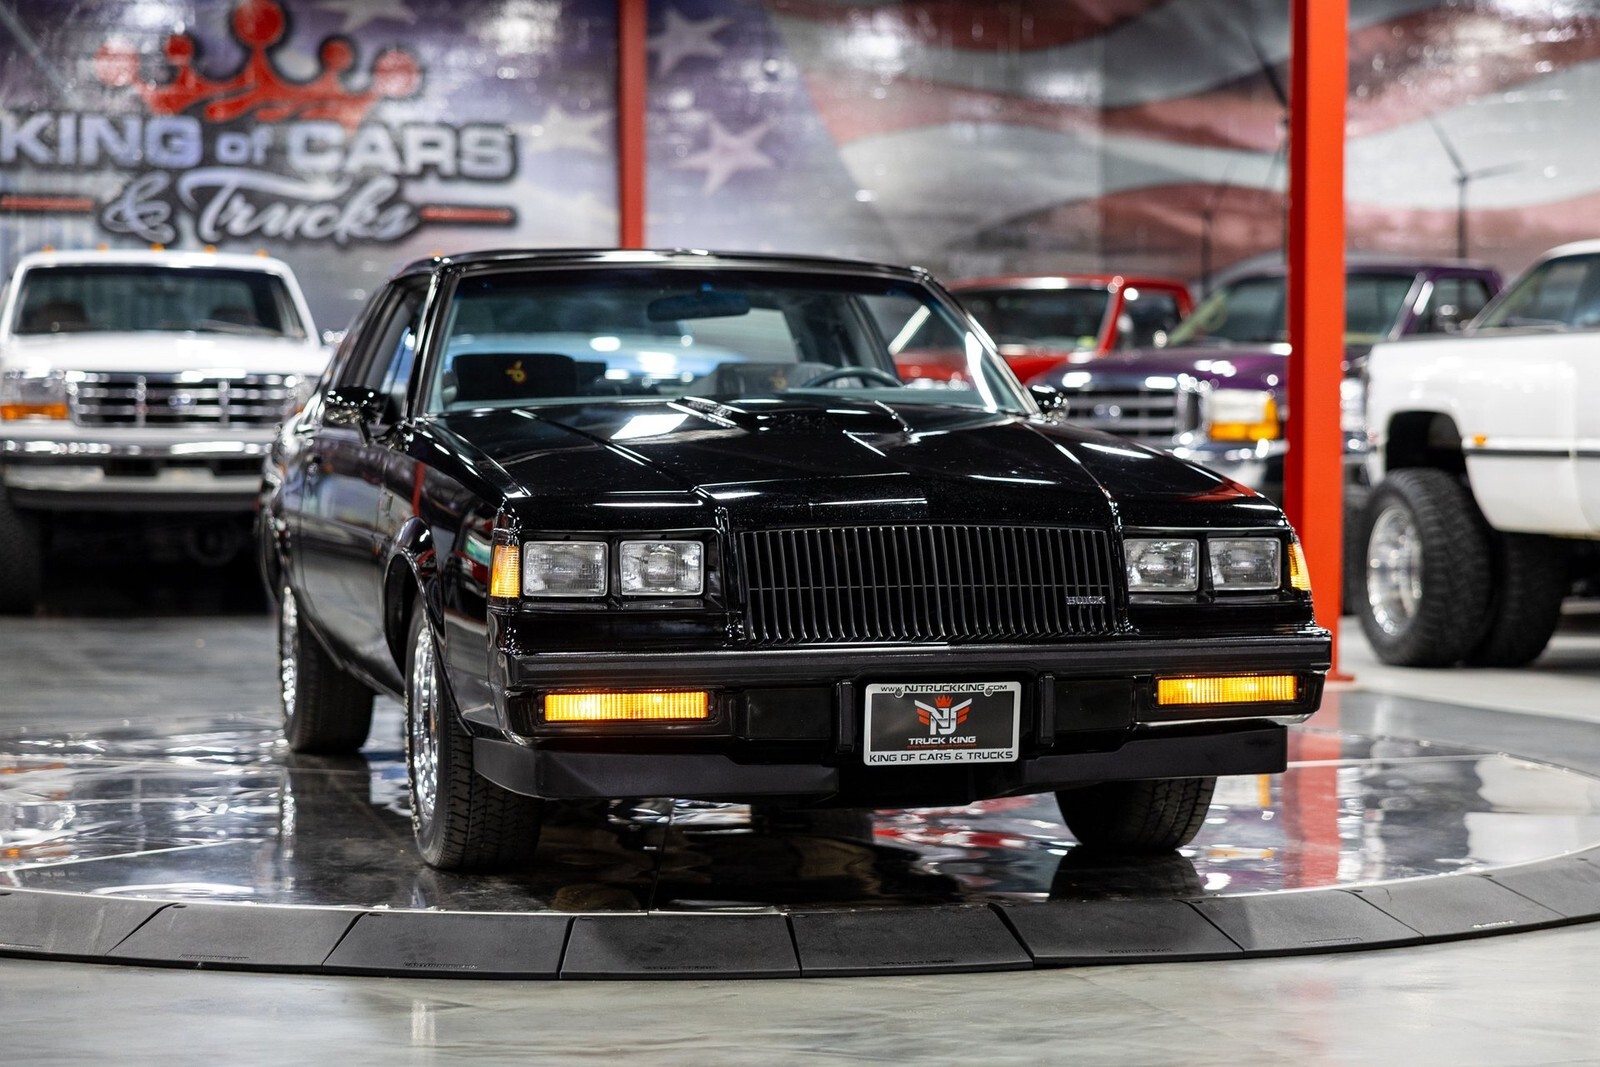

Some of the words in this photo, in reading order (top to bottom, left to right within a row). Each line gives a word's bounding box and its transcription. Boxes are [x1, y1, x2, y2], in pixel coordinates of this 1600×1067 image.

[0, 114, 200, 170] KING
[289, 125, 514, 179] CARS
[102, 170, 177, 242] &
[178, 166, 420, 243] Trucks
[1066, 596, 1106, 604] BUICK
[908, 737, 946, 745] TRUCK
[949, 735, 977, 744] KING
[869, 753, 897, 763] KING
[901, 753, 916, 762] OF
[919, 752, 951, 761] CARS
[955, 752, 963, 760] &
[967, 751, 1013, 760] TRUCKS
